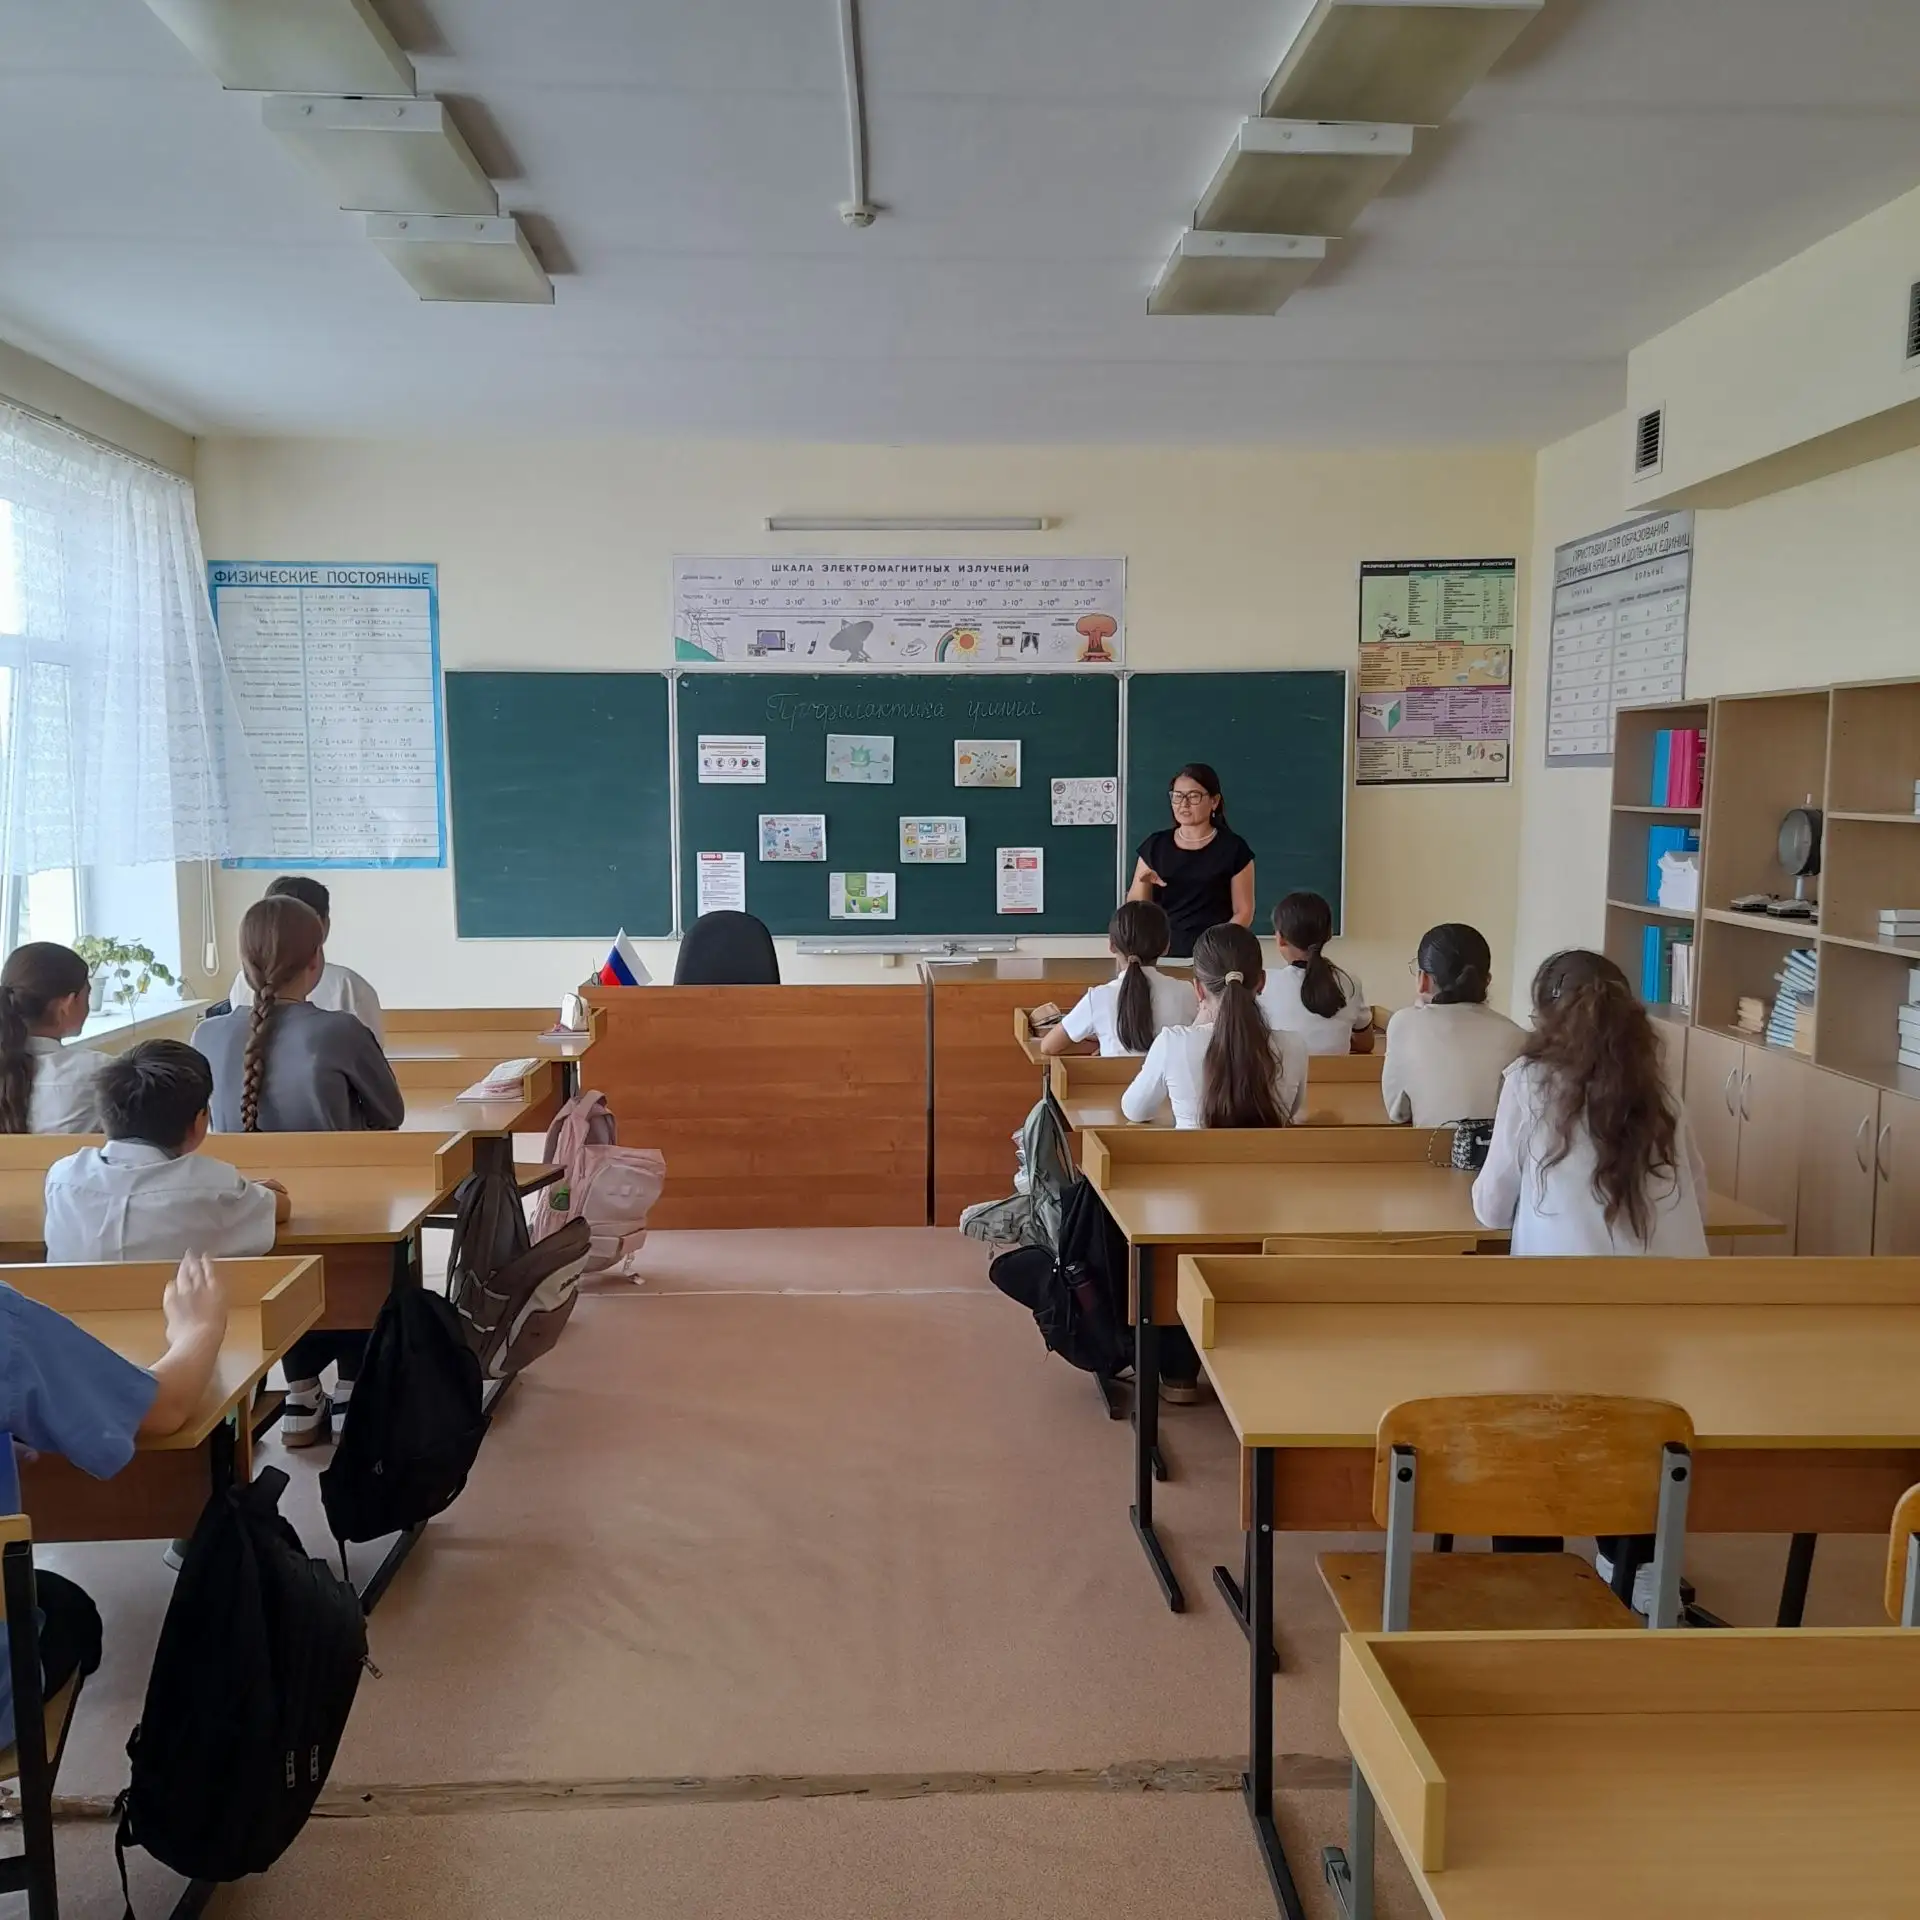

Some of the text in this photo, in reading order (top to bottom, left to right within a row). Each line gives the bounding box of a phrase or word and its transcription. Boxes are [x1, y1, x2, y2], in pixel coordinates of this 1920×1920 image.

[771, 563, 1030, 573] ШКАЛА ЭЛЕКТРОМАГНИТНЫХ ИЗЛУЧЕНИЙ
[214, 570, 430, 585] ФИЗИЧЕСКИЕ ПОСТОЯННЫЕ
